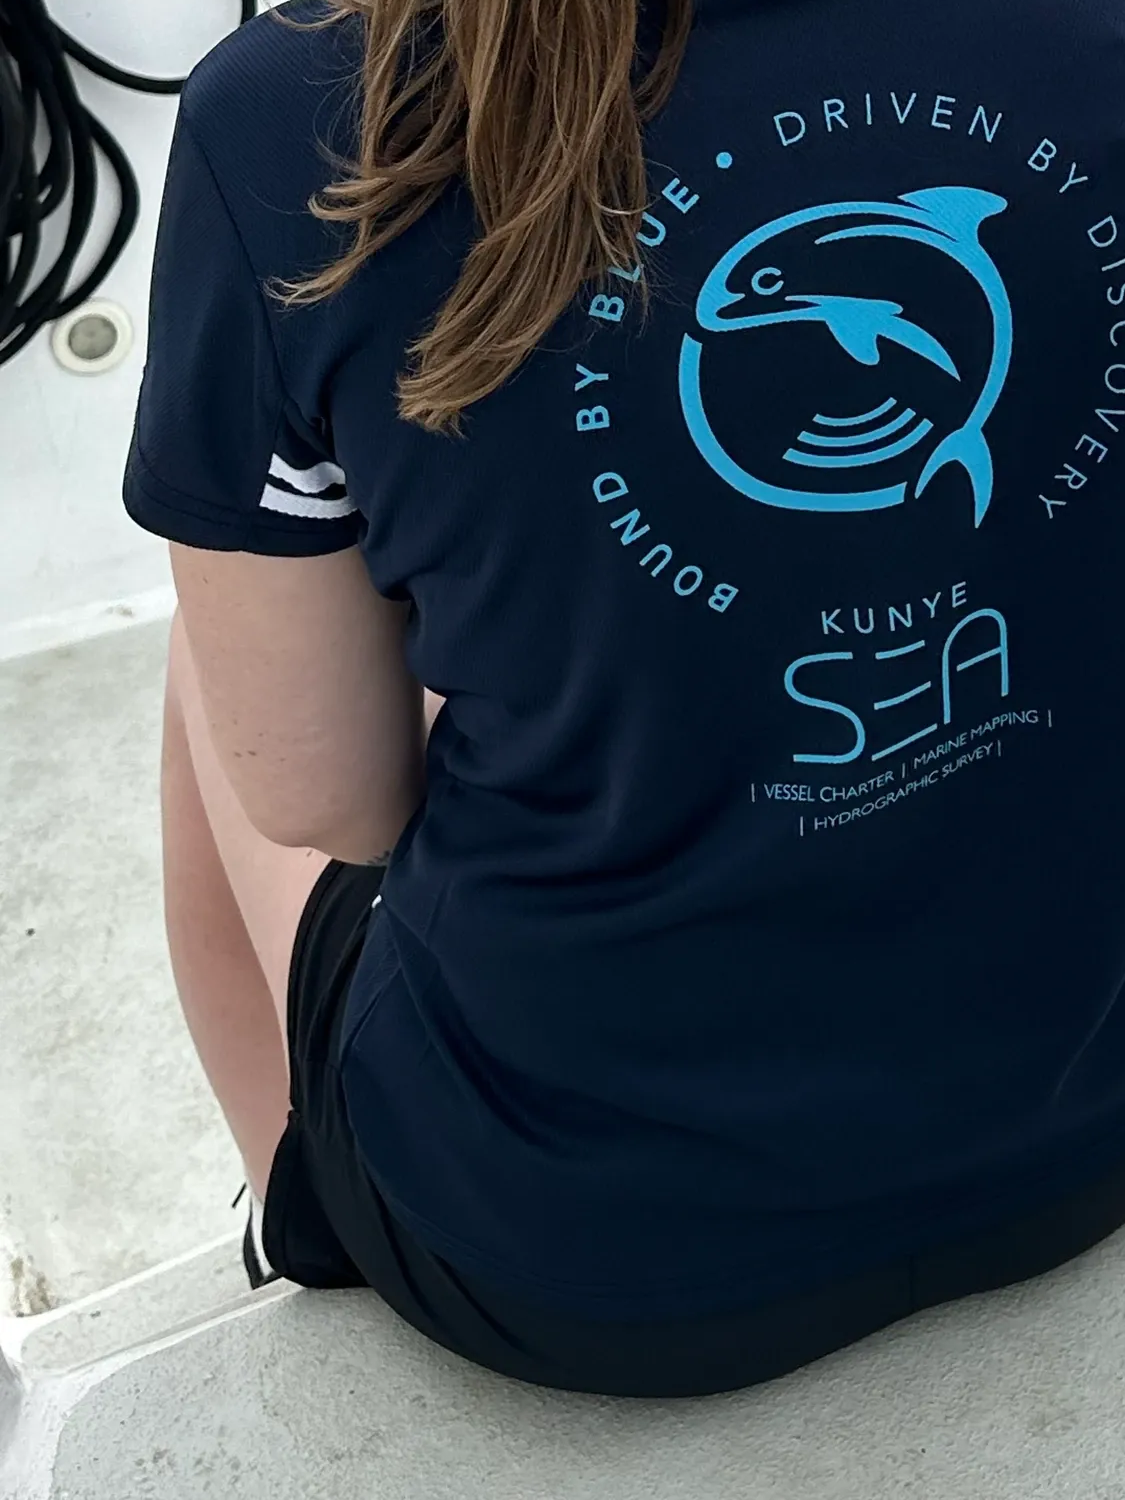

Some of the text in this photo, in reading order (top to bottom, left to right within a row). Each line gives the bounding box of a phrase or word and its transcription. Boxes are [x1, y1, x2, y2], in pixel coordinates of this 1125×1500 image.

[772, 91, 1003, 147] DRIVEN
[1027, 137, 1089, 194] BY
[588, 177, 700, 322] BLUE
[574, 363, 610, 432] BY
[592, 471, 739, 613] BOUND
[821, 581, 967, 635] KUNYE
[783, 608, 1009, 765] SEA
[763, 709, 1039, 803] VESSEL CHARTER MARINE MAPPING
[814, 742, 994, 831] HYDROGRAPHIC SURVEY
